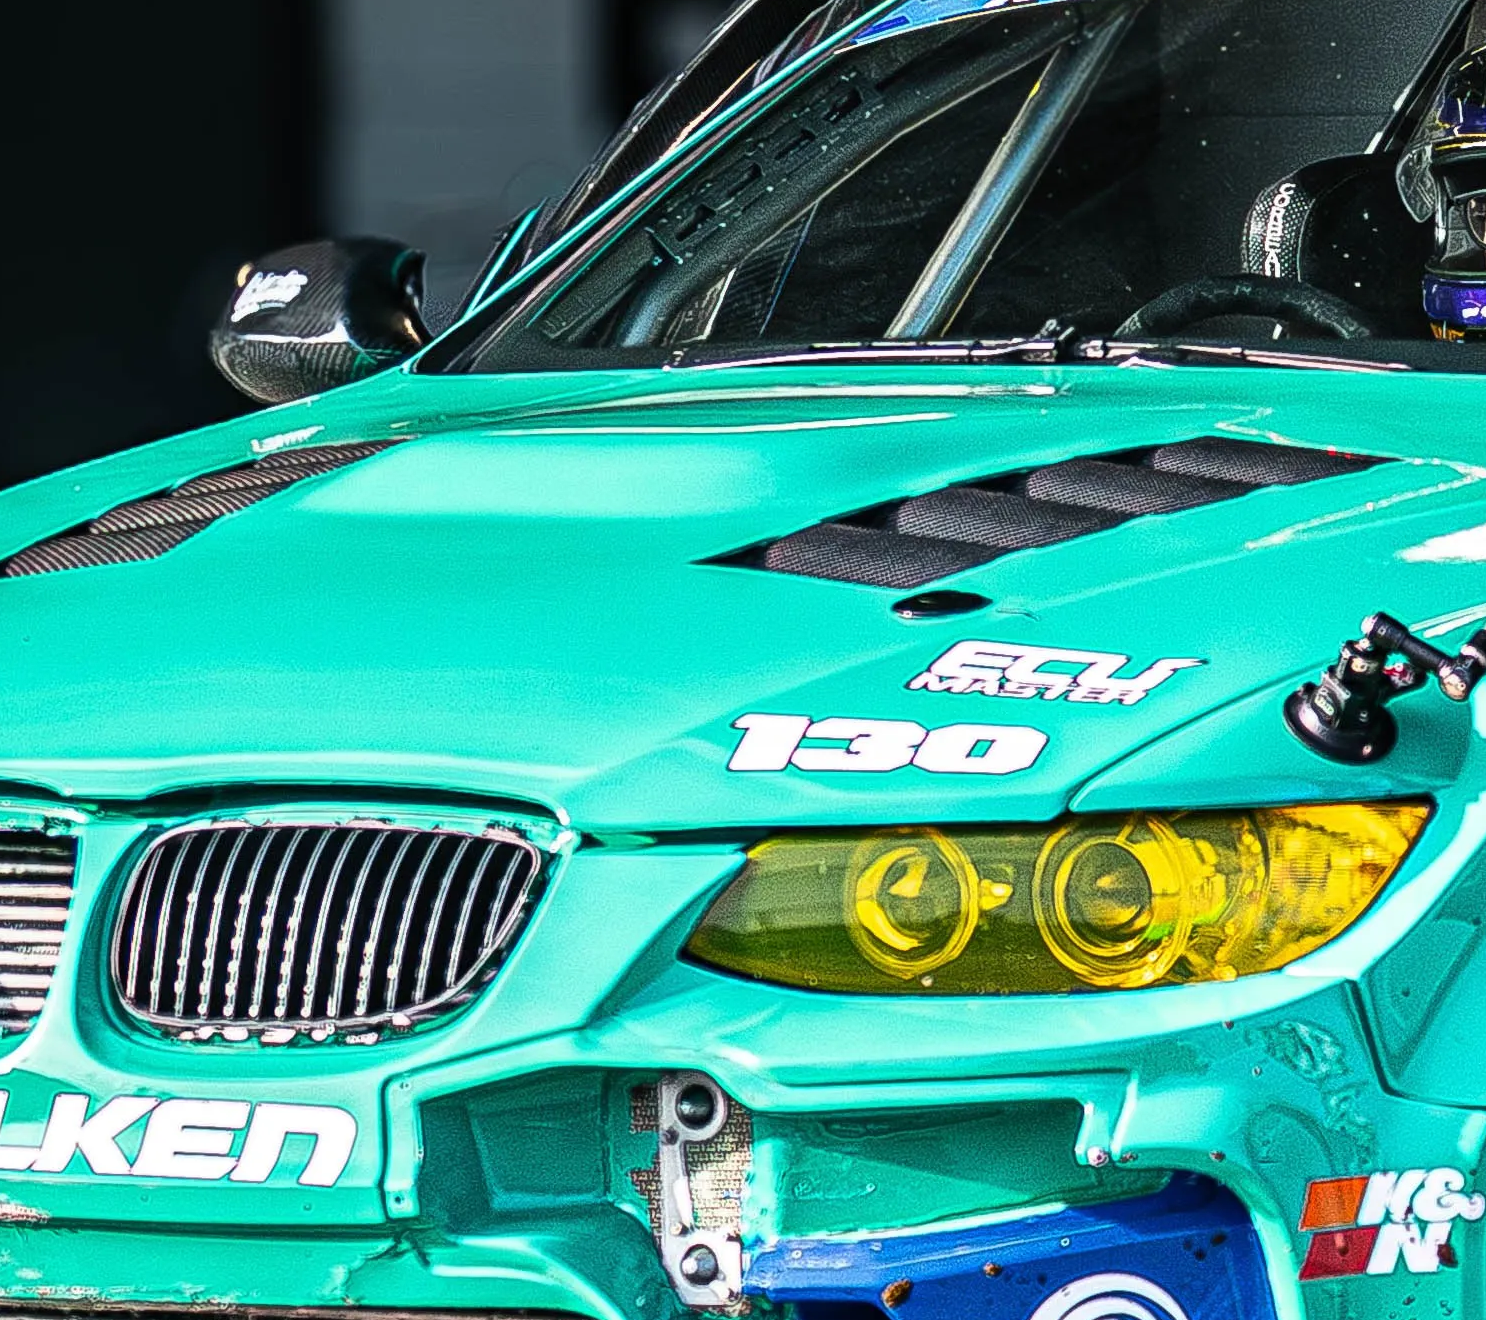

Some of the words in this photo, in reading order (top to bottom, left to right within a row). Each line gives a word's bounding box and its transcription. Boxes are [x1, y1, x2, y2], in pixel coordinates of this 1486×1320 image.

[905, 671, 1149, 705] MASTER
[929, 640, 1208, 691] ECU
[727, 713, 1050, 775] 130
